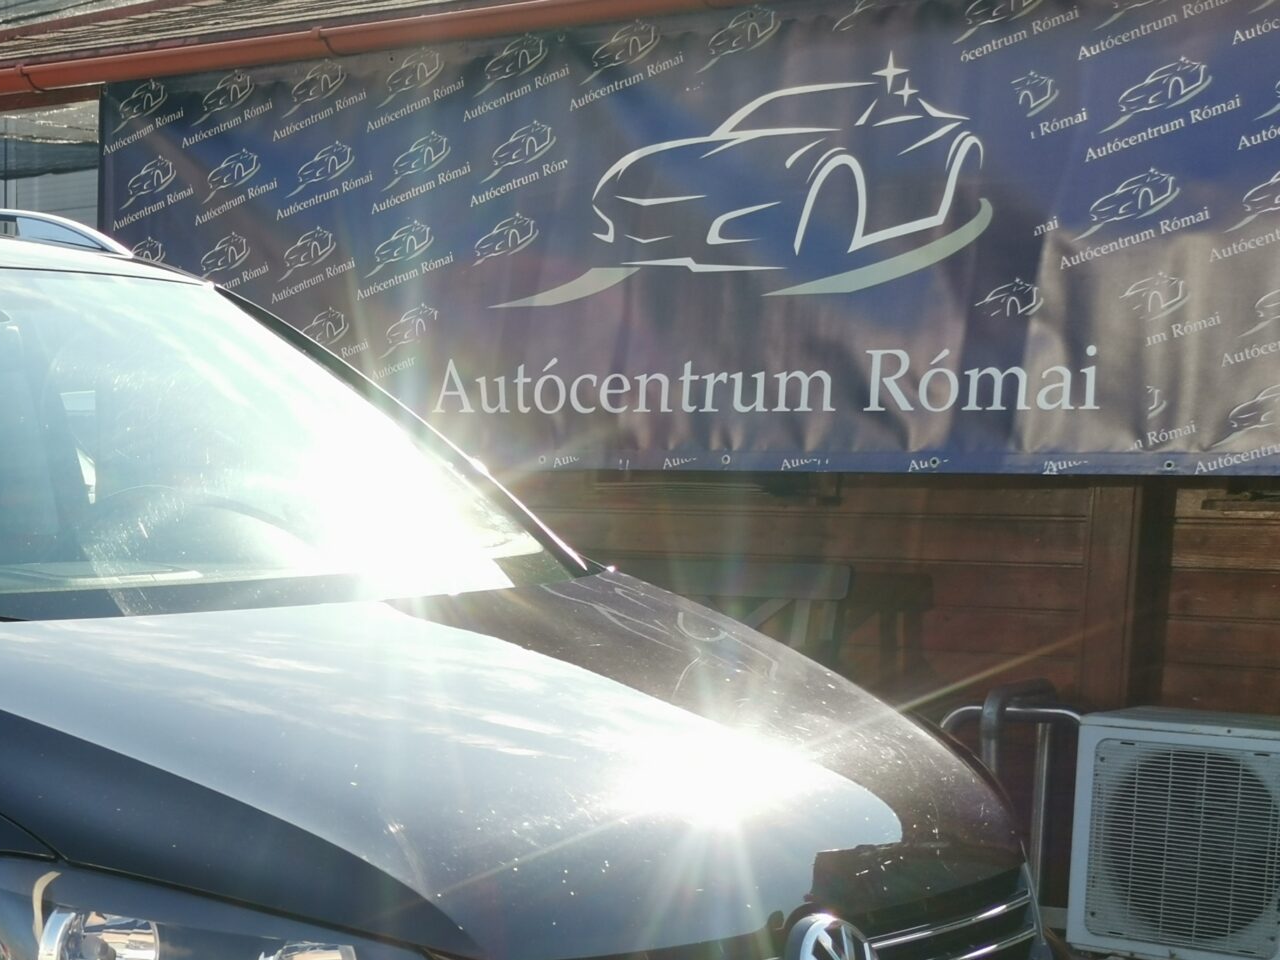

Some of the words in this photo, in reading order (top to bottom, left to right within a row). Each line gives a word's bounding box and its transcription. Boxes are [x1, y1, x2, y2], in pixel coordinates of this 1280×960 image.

[1032, 7, 1079, 35] Római
[1078, 12, 1177, 61] Autócentrum
[366, 95, 430, 133] Autócentrum
[433, 77, 465, 104] Római
[463, 86, 531, 122] Autócentrum
[534, 64, 570, 91] Római
[569, 73, 645, 111] Autócentrum
[647, 53, 684, 78] Római
[102, 123, 154, 155] Autócentrum
[155, 107, 184, 127] Római
[181, 116, 242, 148] Autócentrum
[244, 101, 273, 121] Római
[273, 108, 334, 141] Autócentrum
[335, 92, 367, 113] Római
[1040, 108, 1087, 135] Római
[1085, 117, 1184, 161] Autócentrum
[1190, 94, 1241, 122] Római
[113, 198, 165, 230] Autócentrum
[167, 185, 194, 205] Római
[195, 194, 246, 226] Autócentrum
[247, 178, 277, 200] Római
[276, 188, 340, 220] Autócentrum
[341, 171, 373, 192] Római
[372, 181, 435, 214] Autócentrum
[438, 162, 471, 186] Római
[470, 172, 538, 207] Autócentrum
[1060, 229, 1155, 269] Autócentrum
[1160, 207, 1210, 233] Római
[242, 264, 269, 284] Római
[272, 276, 324, 304] Autócentrum
[326, 258, 355, 279] Római
[357, 269, 418, 302] Autócentrum
[420, 251, 454, 277] Római
[1172, 312, 1221, 338] Római
[341, 341, 369, 358] Római
[431, 358, 835, 415] Autócentrum
[863, 345, 1100, 413] Római
[1147, 421, 1196, 446] Római
